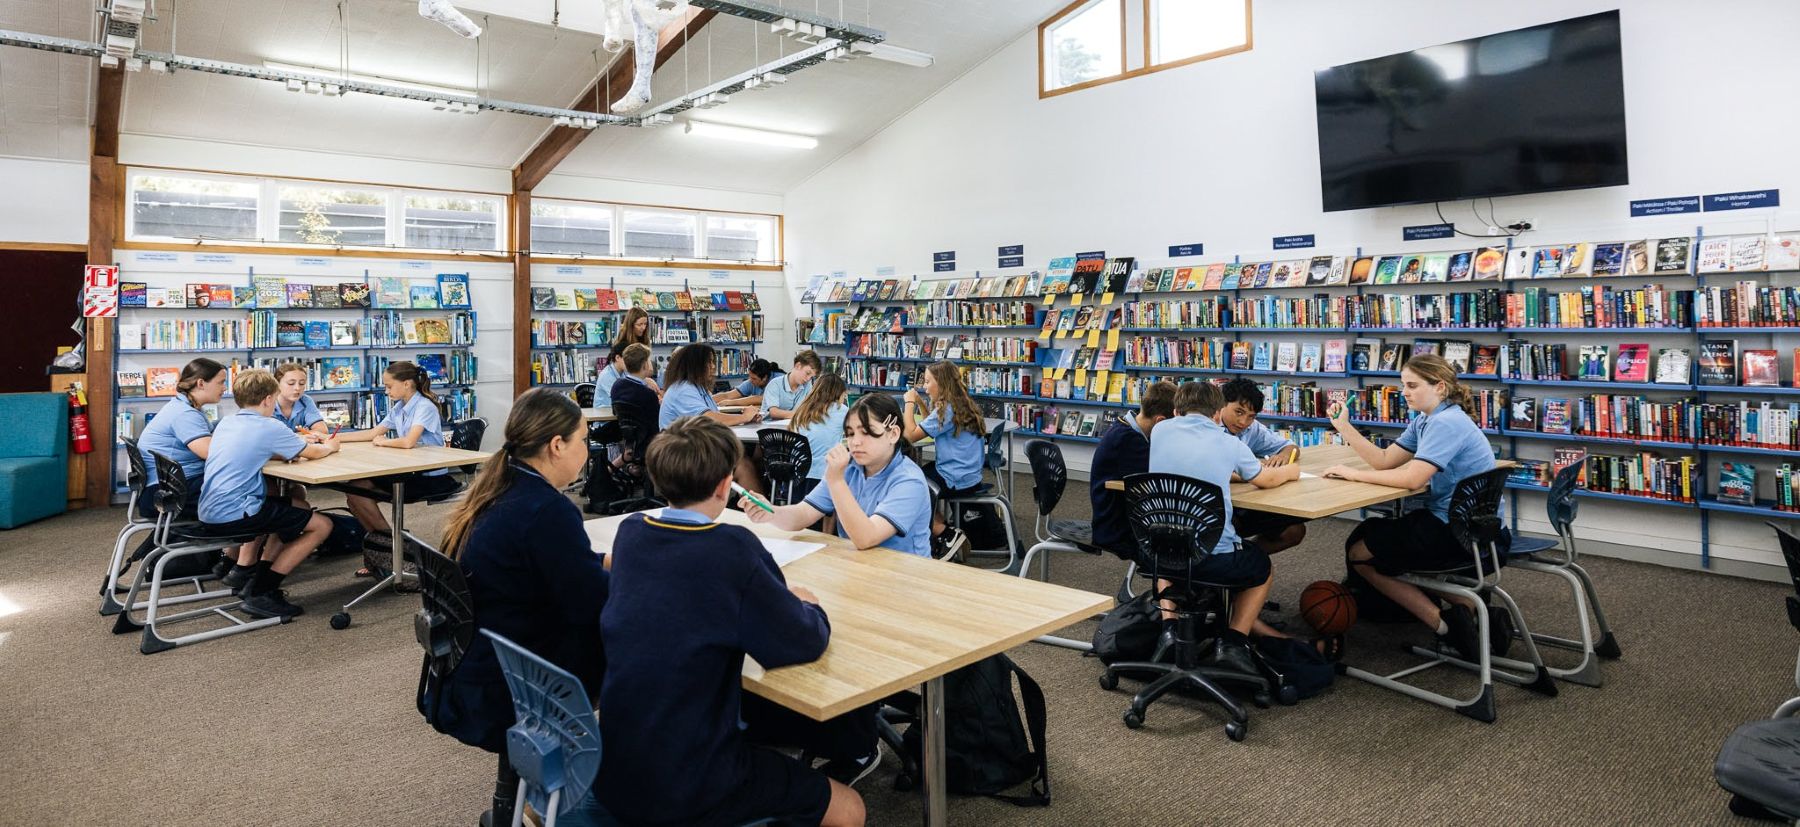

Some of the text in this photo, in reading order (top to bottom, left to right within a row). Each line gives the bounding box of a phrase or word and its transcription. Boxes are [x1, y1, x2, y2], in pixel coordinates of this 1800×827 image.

[1705, 243, 1727, 251] CATCH
[1105, 262, 1128, 275] ATUA
[1560, 452, 1578, 460] LEE
